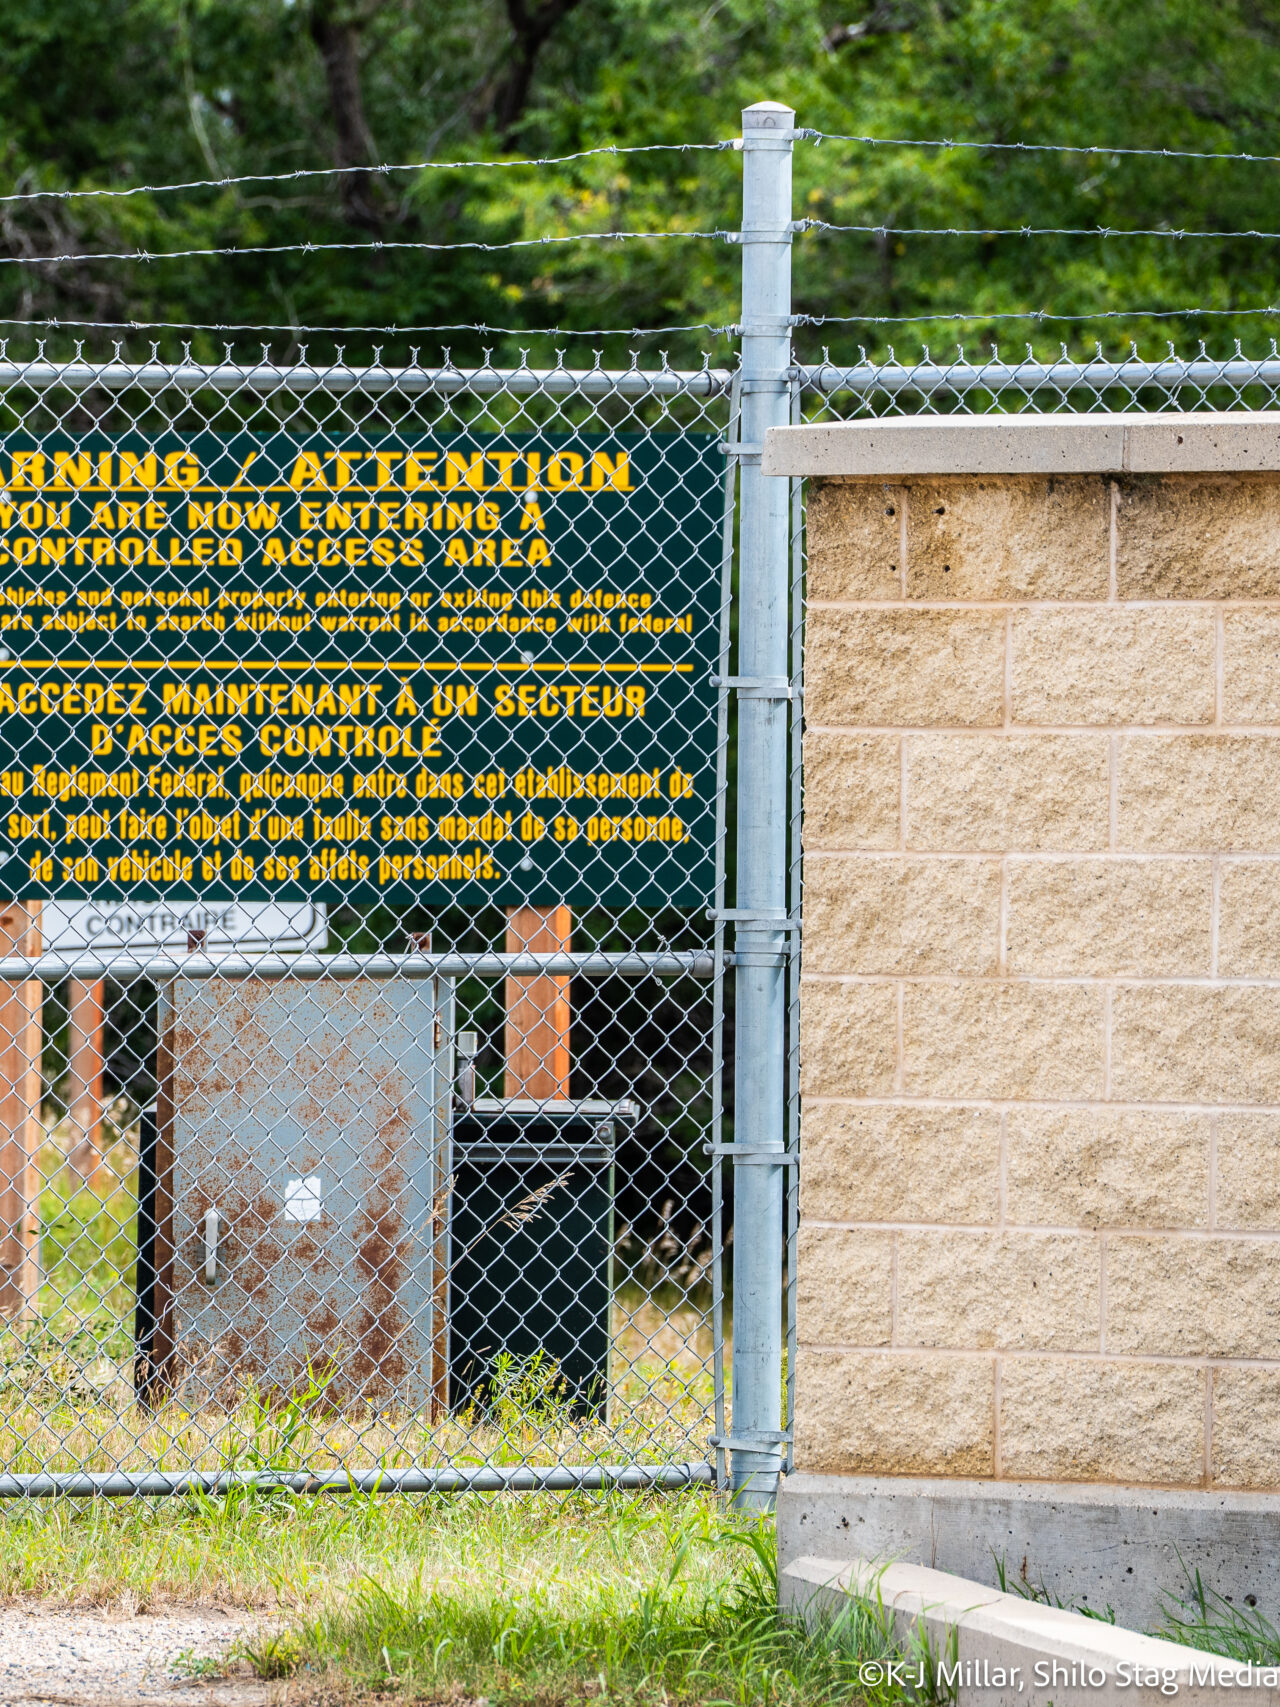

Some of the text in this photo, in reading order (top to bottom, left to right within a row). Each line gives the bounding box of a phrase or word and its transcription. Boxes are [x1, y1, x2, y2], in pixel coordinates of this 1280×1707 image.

[233, 451, 258, 486] /
[288, 451, 631, 487] ATTENTION
[90, 501, 167, 530] ARE
[187, 501, 281, 531] NOW
[299, 501, 500, 531] ENTERING
[519, 501, 546, 531] A
[261, 537, 425, 567] ACCESS
[444, 538, 552, 568] AREA
[76, 587, 114, 607] and
[120, 588, 210, 609] personal
[214, 588, 307, 610] property
[314, 588, 402, 611] entering
[409, 592, 433, 608] or
[440, 588, 513, 611] exiting
[521, 588, 561, 609] this
[569, 588, 652, 609] defence
[0, 614, 33, 631] are
[41, 611, 117, 634] subject
[125, 612, 147, 631] to
[155, 612, 226, 632] search
[233, 612, 312, 632] without
[320, 613, 401, 632] warrant
[409, 613, 429, 633] in
[437, 613, 557, 633] accordance
[567, 614, 611, 633] with
[619, 614, 693, 634] federal
[162, 683, 383, 716] MAINTENANT
[394, 676, 418, 716] À
[432, 684, 478, 717] UN
[494, 684, 646, 718] SECTEUR
[259, 718, 443, 758] CONTROLÉ
[0, 771, 24, 797] au
[239, 766, 345, 804] quiconque
[352, 767, 408, 799] entre
[415, 766, 465, 799] dans
[473, 767, 506, 799] cet
[514, 765, 661, 799] établissement
[669, 765, 694, 799] de
[7, 809, 57, 841] sort,
[65, 808, 111, 845] peut
[119, 807, 167, 841] faire
[380, 815, 430, 842] sans
[438, 810, 513, 841] mandat
[520, 810, 545, 842] de
[553, 815, 578, 842] sa
[586, 815, 690, 846] personne,
[29, 849, 54, 883] de
[61, 856, 99, 883] son
[201, 850, 222, 882] et
[230, 848, 255, 882] de
[263, 855, 301, 881] ses
[378, 847, 501, 886] personnels.
[86, 908, 236, 937] CONTRAIRE
